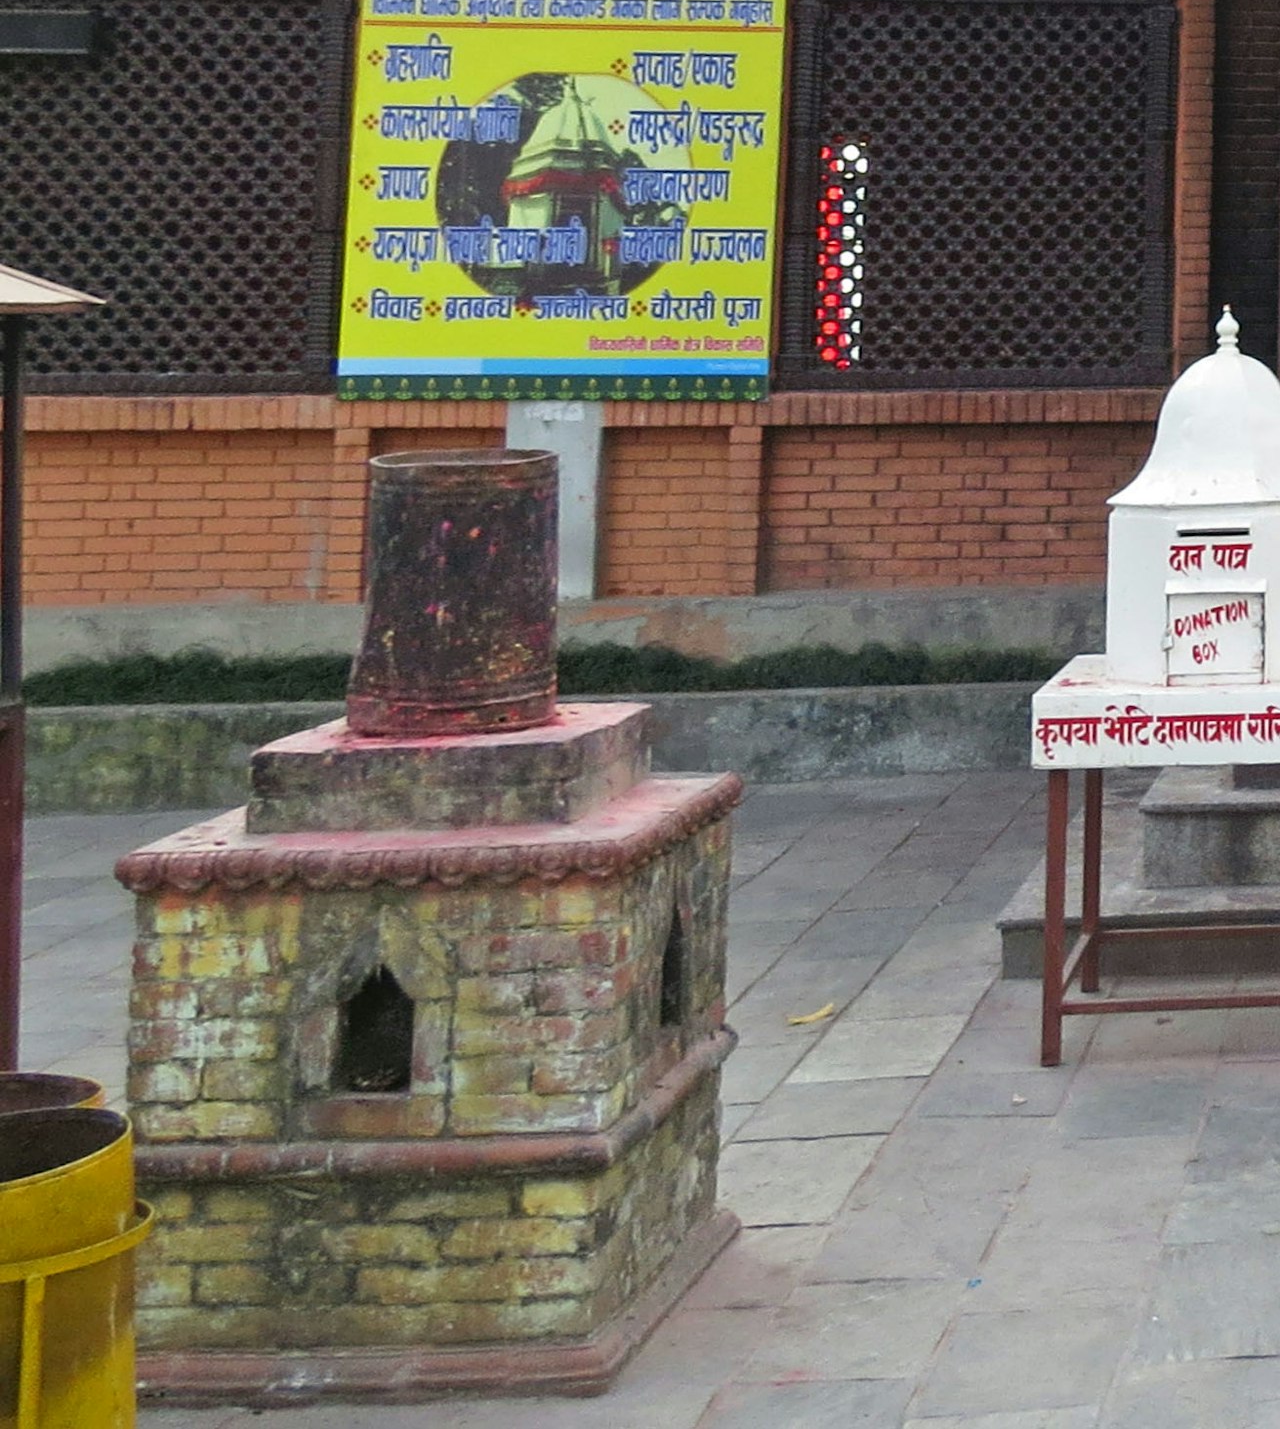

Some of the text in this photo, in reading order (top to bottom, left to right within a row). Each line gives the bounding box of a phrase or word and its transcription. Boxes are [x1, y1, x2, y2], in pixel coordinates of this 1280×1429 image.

[371, 289, 424, 321] विवाह
[533, 289, 629, 321] जन्मोत्सव
[651, 290, 715, 321] चौरासी
[723, 298, 761, 326] पूजा
[1169, 543, 1253, 575] दान पात्र
[1174, 599, 1250, 637] DONATION
[1192, 639, 1221, 664] BOX
[1035, 715, 1102, 759] कृपया
[1152, 712, 1247, 750] दानपात्रमा
